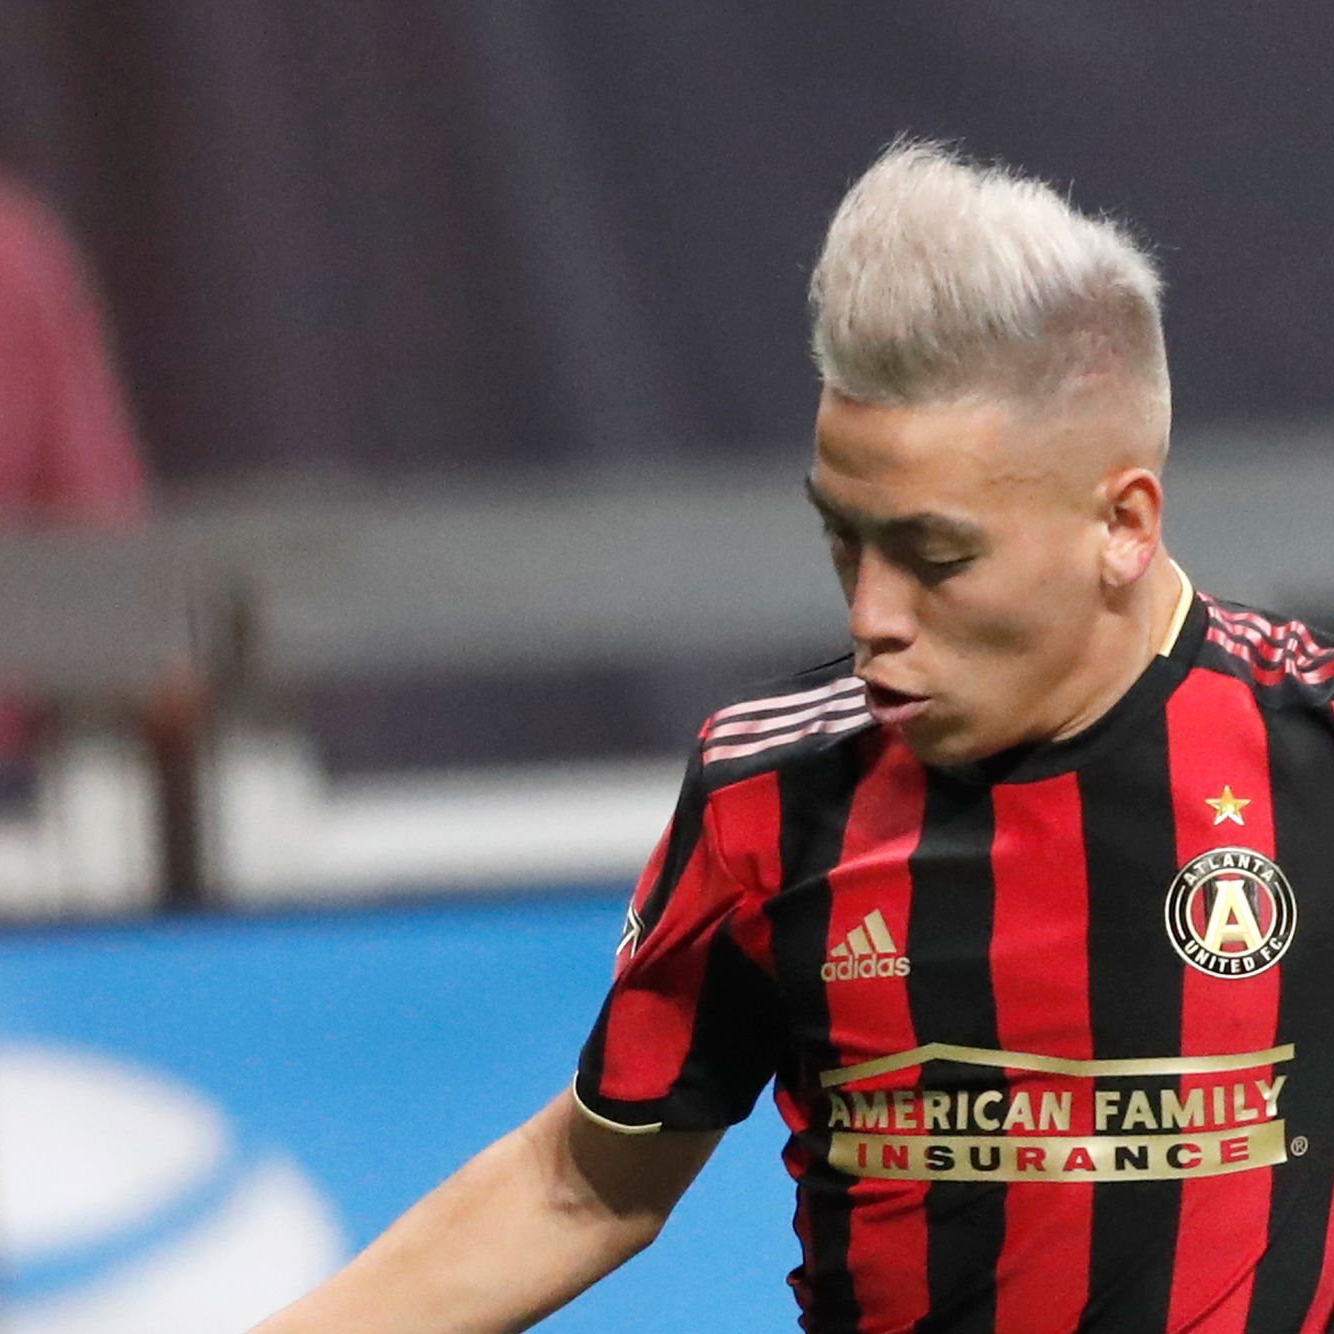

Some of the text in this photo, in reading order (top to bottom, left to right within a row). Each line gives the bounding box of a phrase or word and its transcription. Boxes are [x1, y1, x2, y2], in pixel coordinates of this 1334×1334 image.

[1183, 853, 1275, 886] ATLANTA
[1204, 880, 1264, 952] A
[820, 953, 911, 982] adidas
[1184, 936, 1283, 974] UNITED FC
[828, 1075, 1288, 1132] AMERICAN FAMILY
[857, 1135, 1250, 1172] INSURANCE
